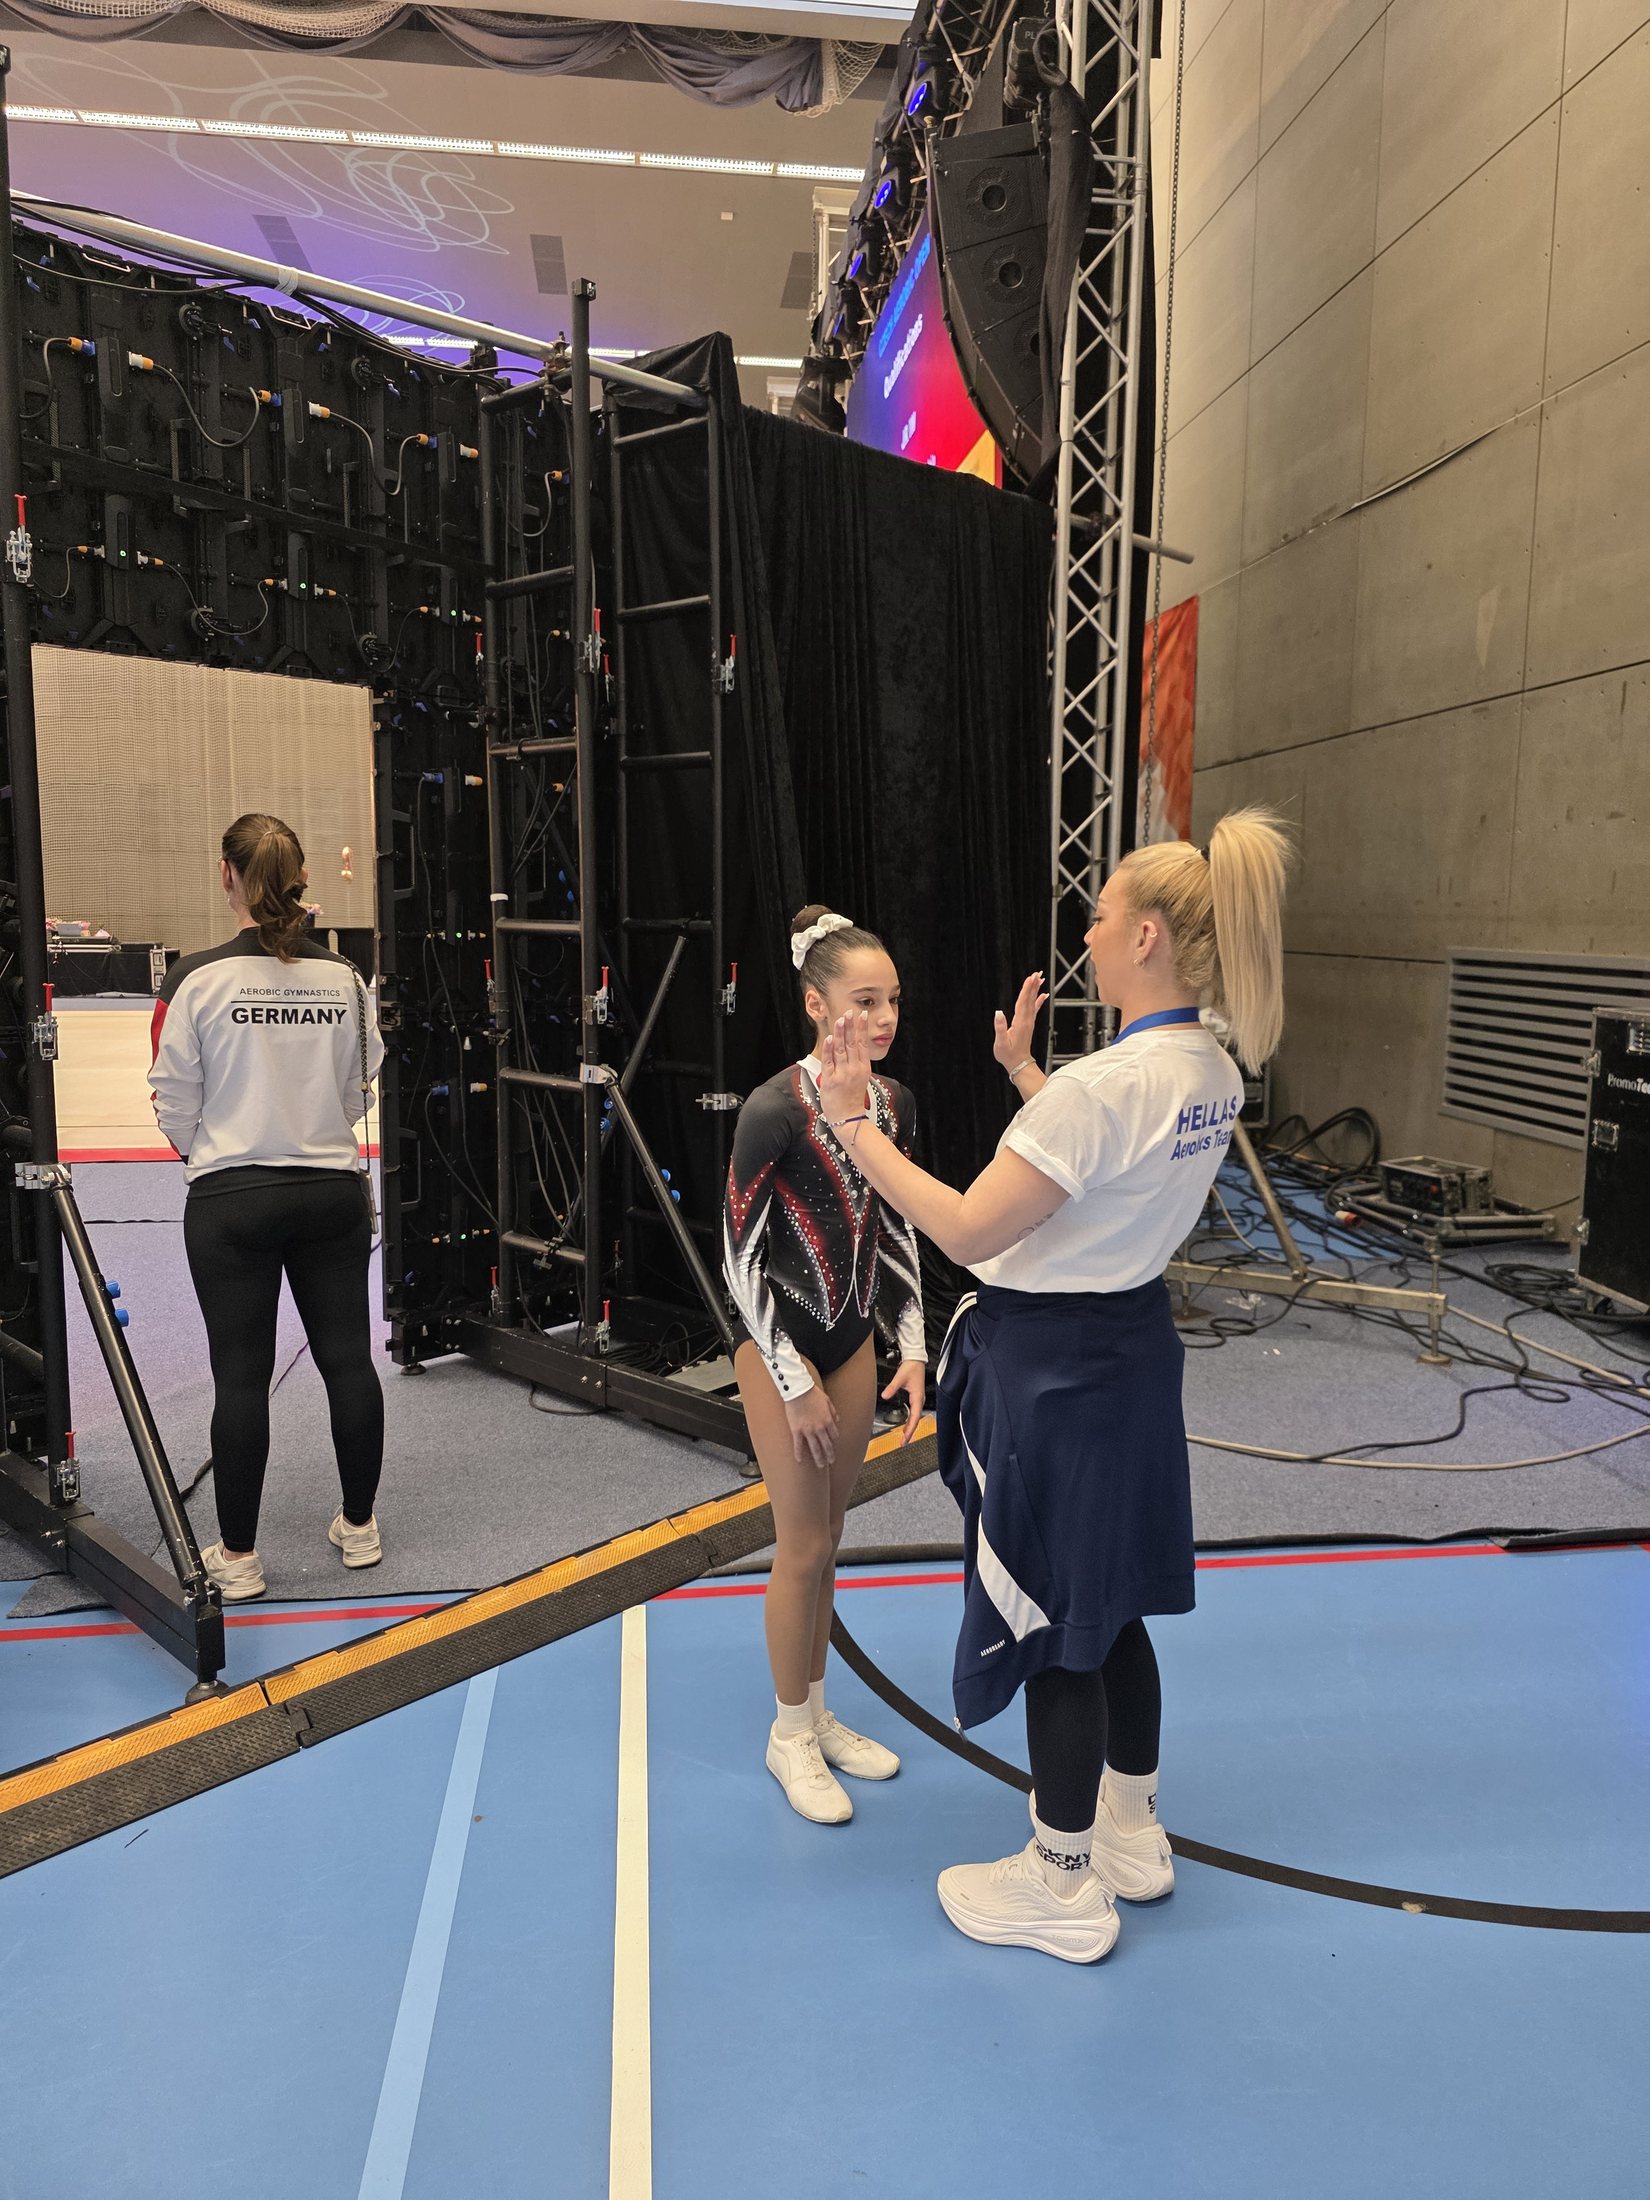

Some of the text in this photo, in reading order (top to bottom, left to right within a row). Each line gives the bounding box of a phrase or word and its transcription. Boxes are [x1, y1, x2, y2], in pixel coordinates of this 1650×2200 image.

[239, 987, 341, 997] AEROBIC GYMNASTICS
[231, 1007, 347, 1025] GERMANY
[1176, 1095, 1237, 1135] HELLAS
